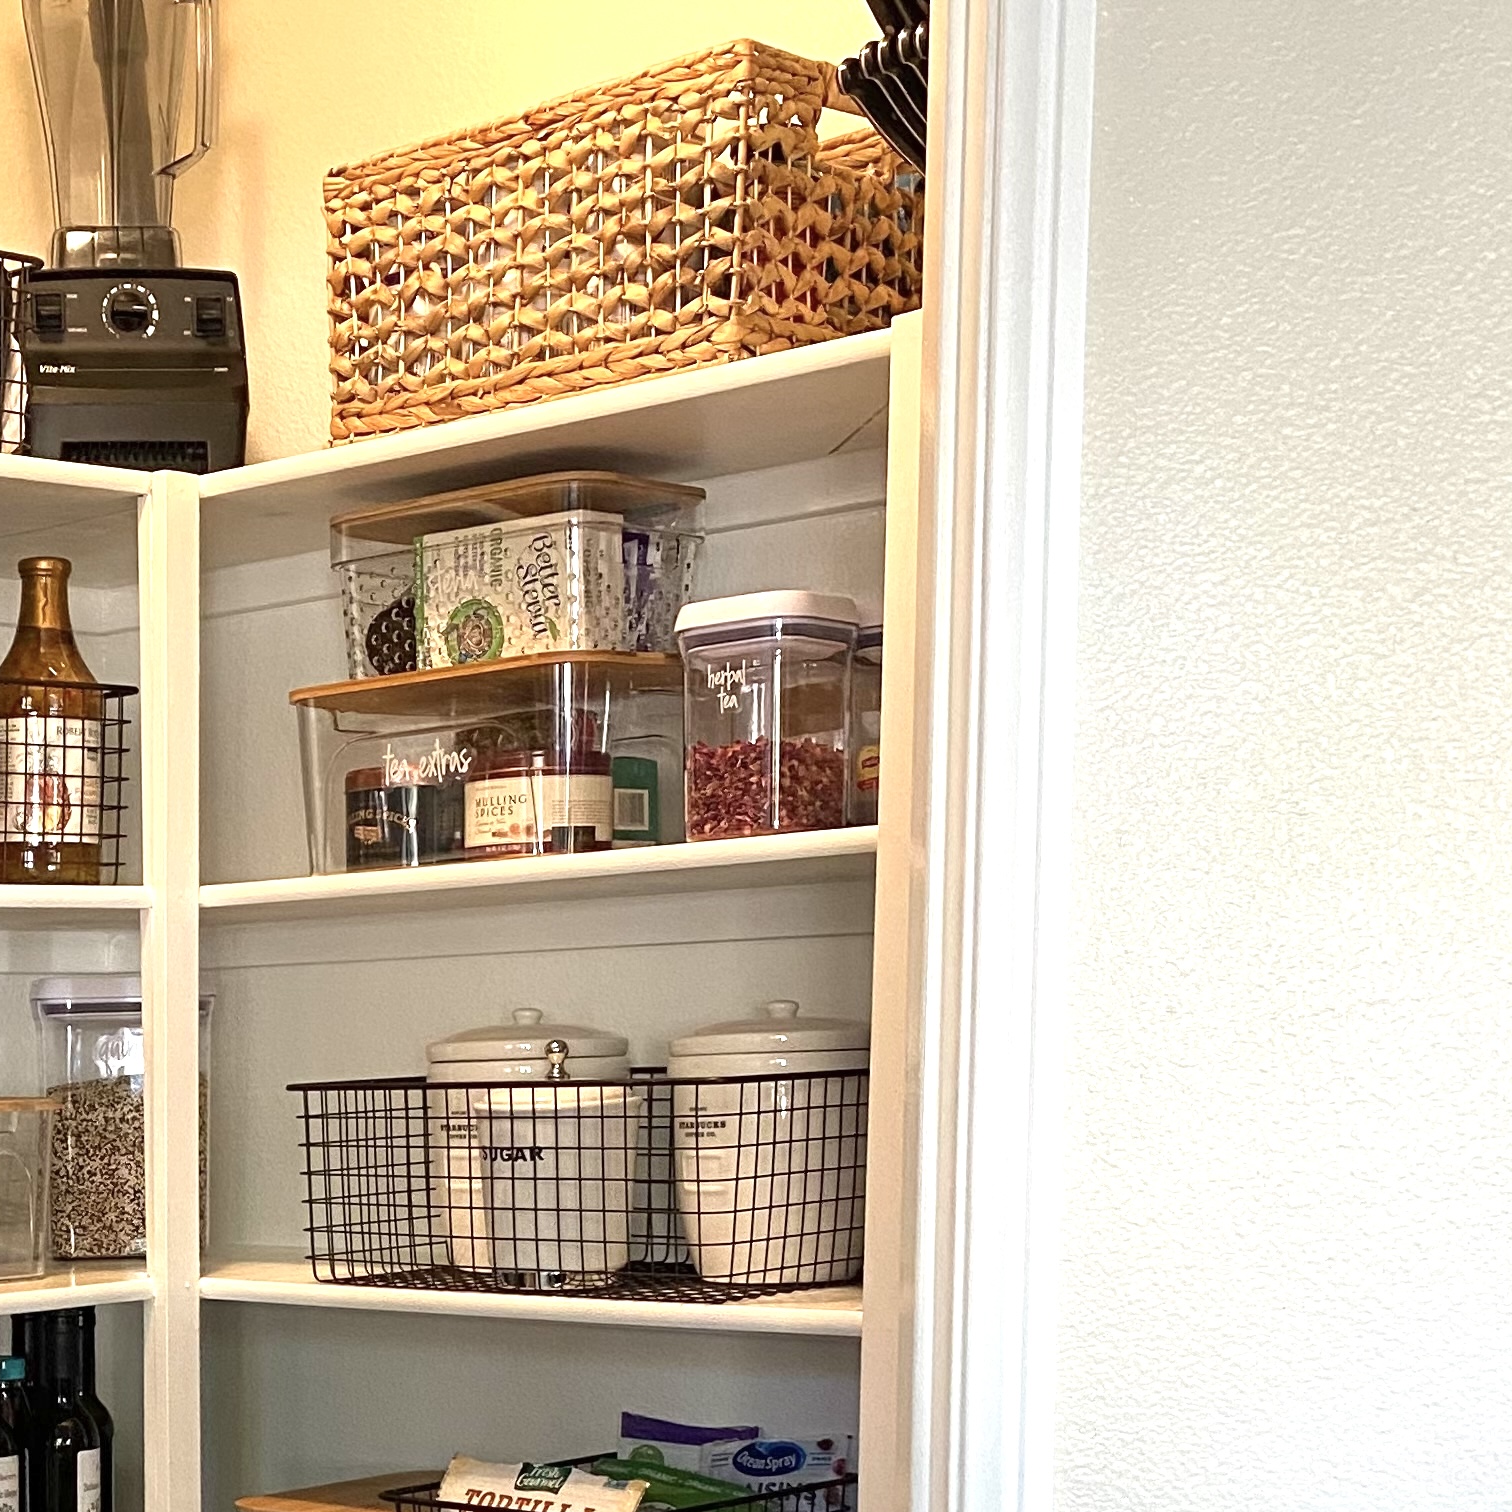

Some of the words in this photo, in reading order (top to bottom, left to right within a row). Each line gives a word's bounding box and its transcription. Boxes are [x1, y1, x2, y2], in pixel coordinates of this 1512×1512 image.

[532, 531, 562, 607] Better
[707, 659, 746, 691] herbal
[717, 687, 739, 714] tea
[382, 743, 410, 787] tea
[418, 738, 472, 783] extras
[475, 793, 528, 809] MULLING
[475, 804, 514, 819] SPICES
[481, 1145, 545, 1162] SUGAR
[736, 1450, 765, 1468] Ocean
[764, 1453, 797, 1472] Spray
